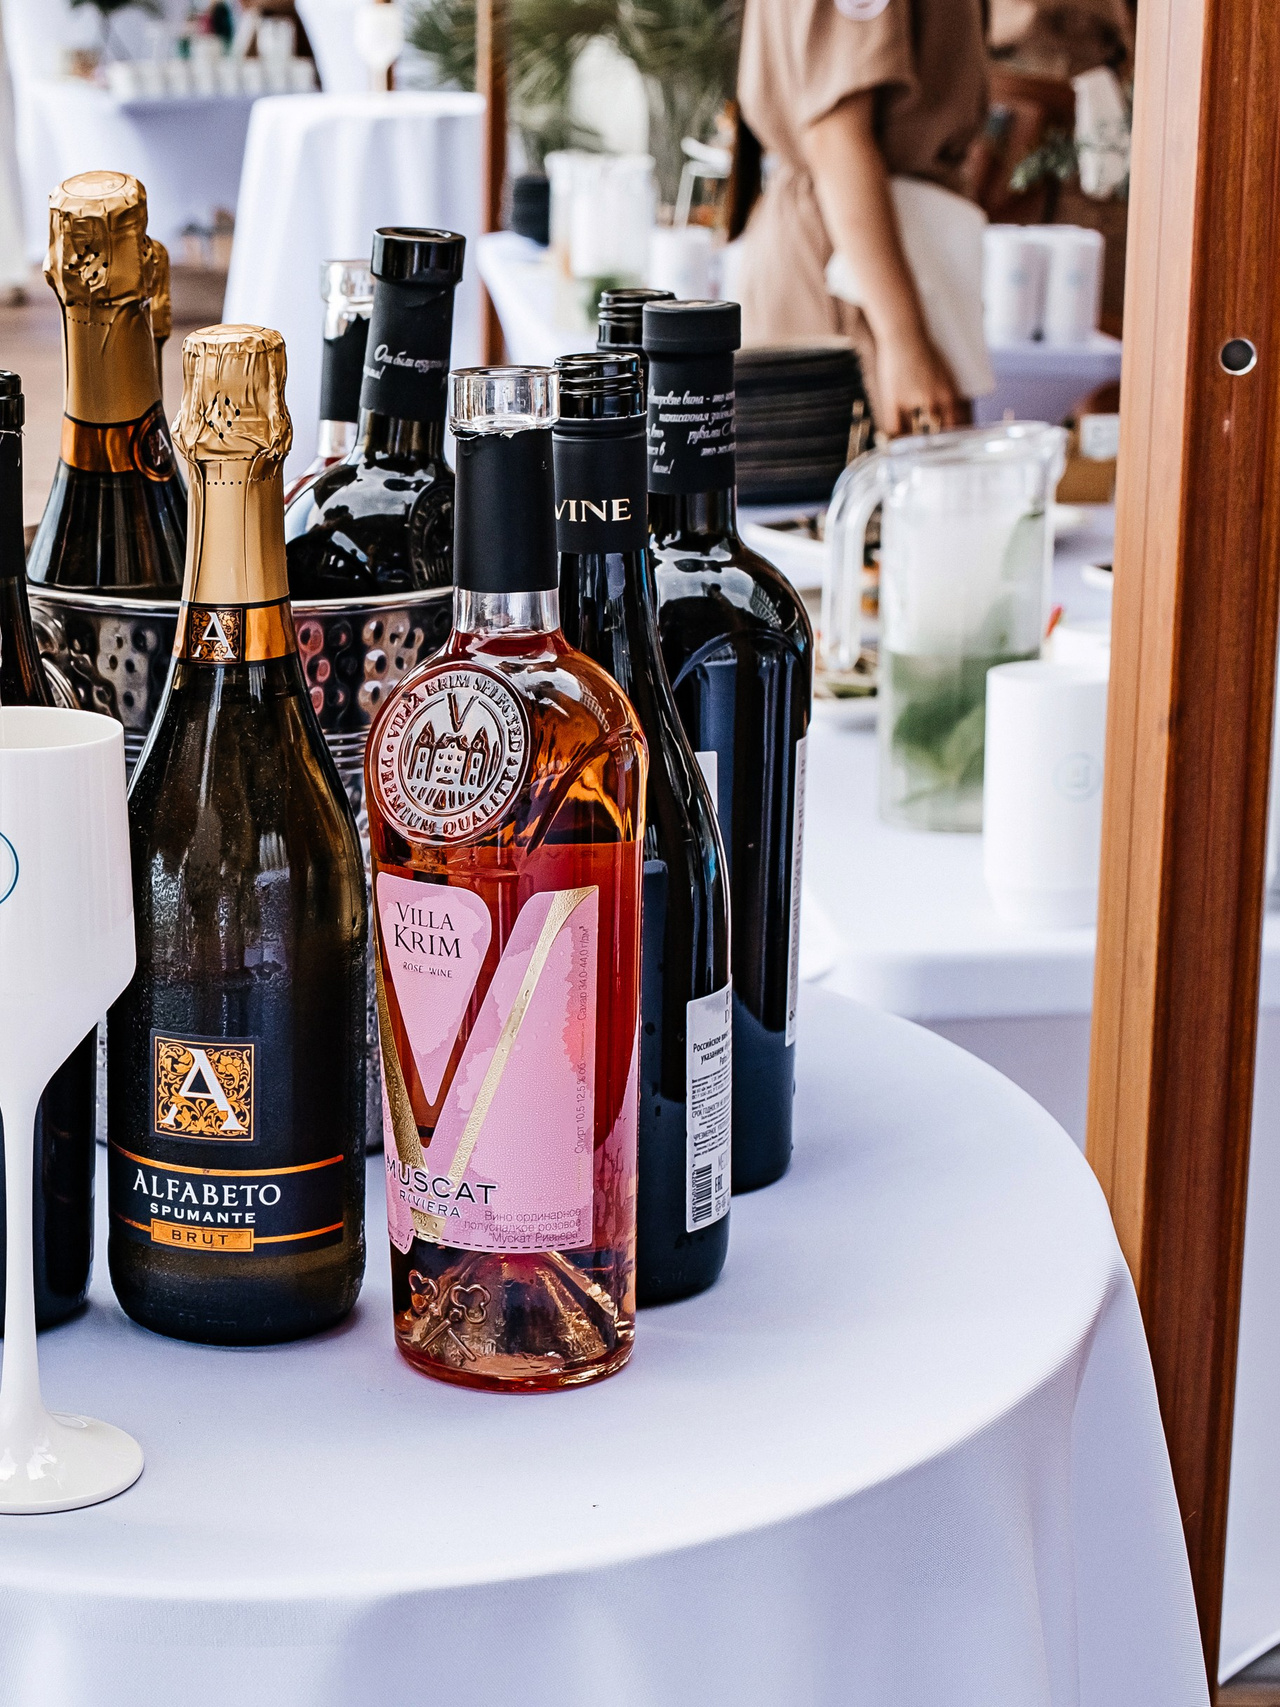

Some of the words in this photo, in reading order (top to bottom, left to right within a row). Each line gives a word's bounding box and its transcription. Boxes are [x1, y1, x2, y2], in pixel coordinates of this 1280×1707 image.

[192, 611, 237, 659] A
[157, 1047, 248, 1131] A
[132, 1168, 282, 1207] ALFABETO
[387, 1154, 496, 1204] MUSCAT
[150, 1202, 256, 1224] SPUMANTE
[400, 1189, 461, 1218] RIVIERA
[484, 1210, 513, 1222] Вино
[171, 1229, 229, 1246] BRUT
